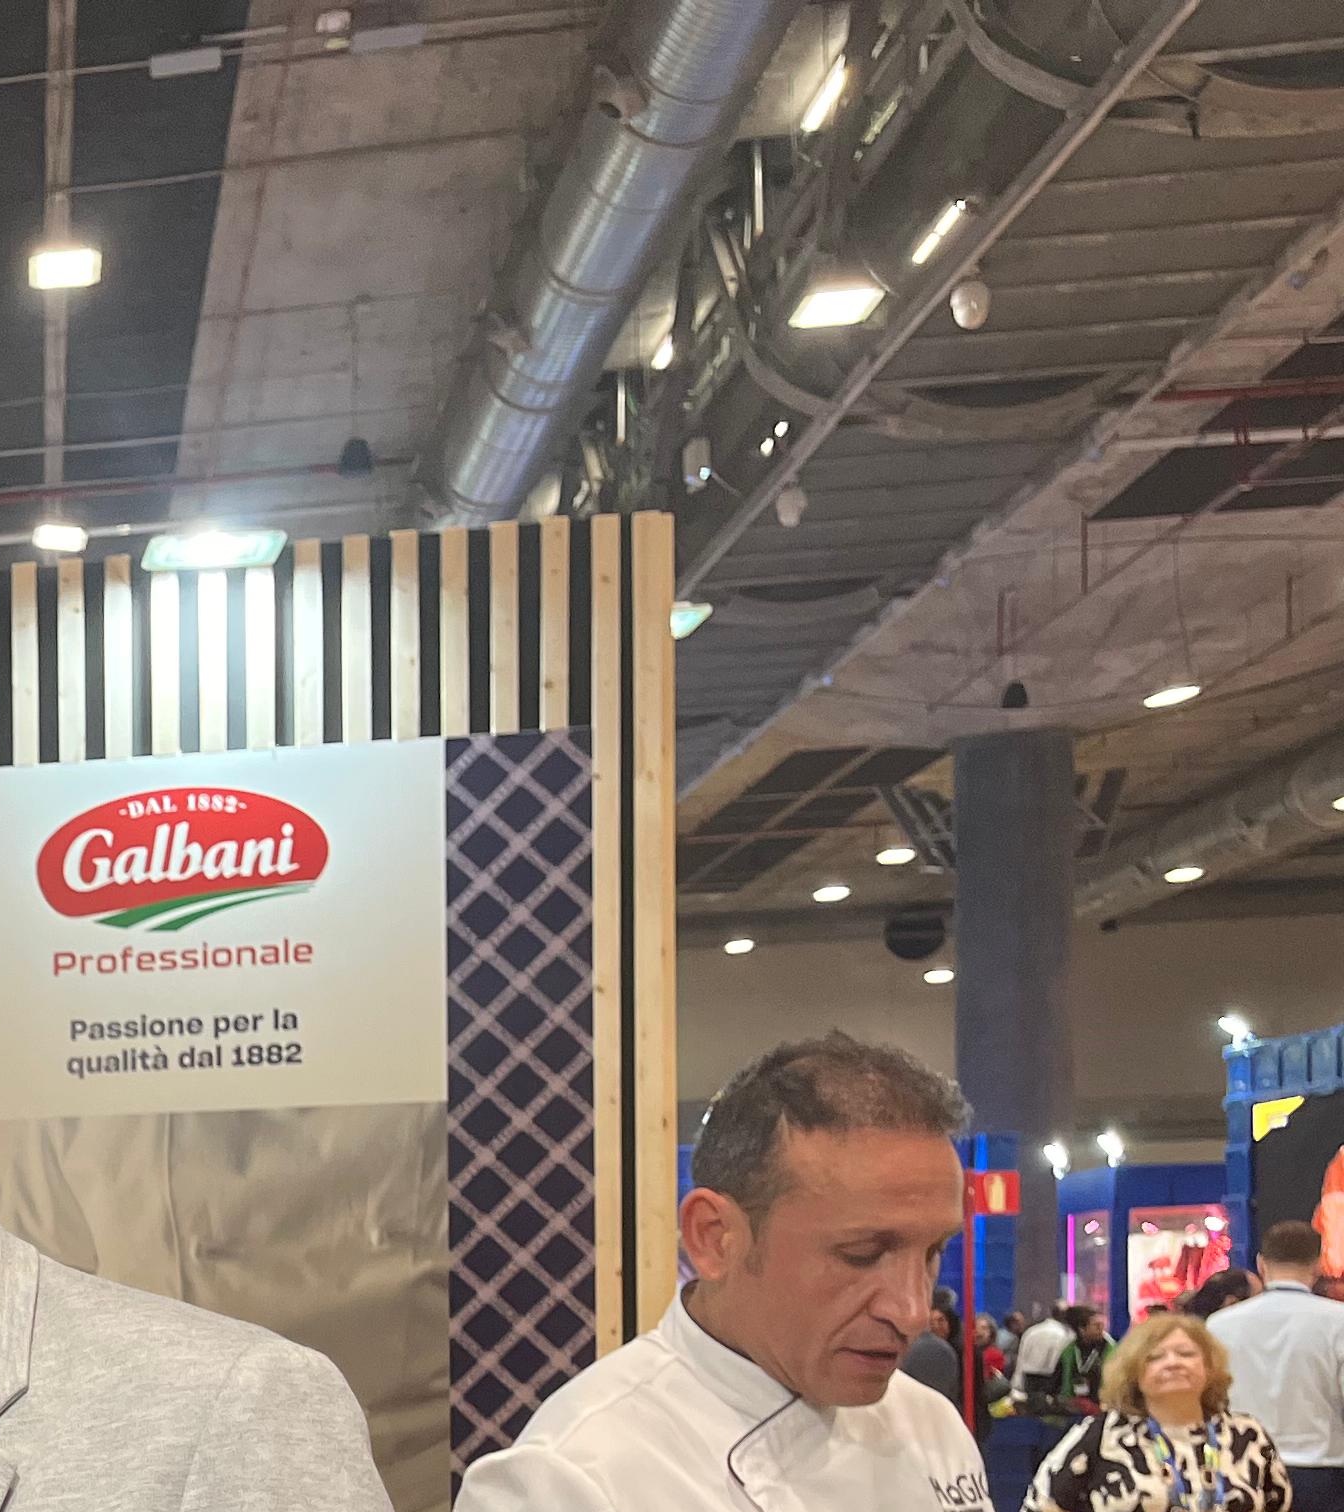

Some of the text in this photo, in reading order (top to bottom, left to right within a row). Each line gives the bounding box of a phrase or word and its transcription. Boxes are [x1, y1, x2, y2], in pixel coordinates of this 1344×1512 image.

[63, 821, 300, 893] Galbani
[53, 938, 314, 976] Professionale
[70, 1008, 298, 1041] Passione per la
[67, 1043, 303, 1079] qualità dal 1882
